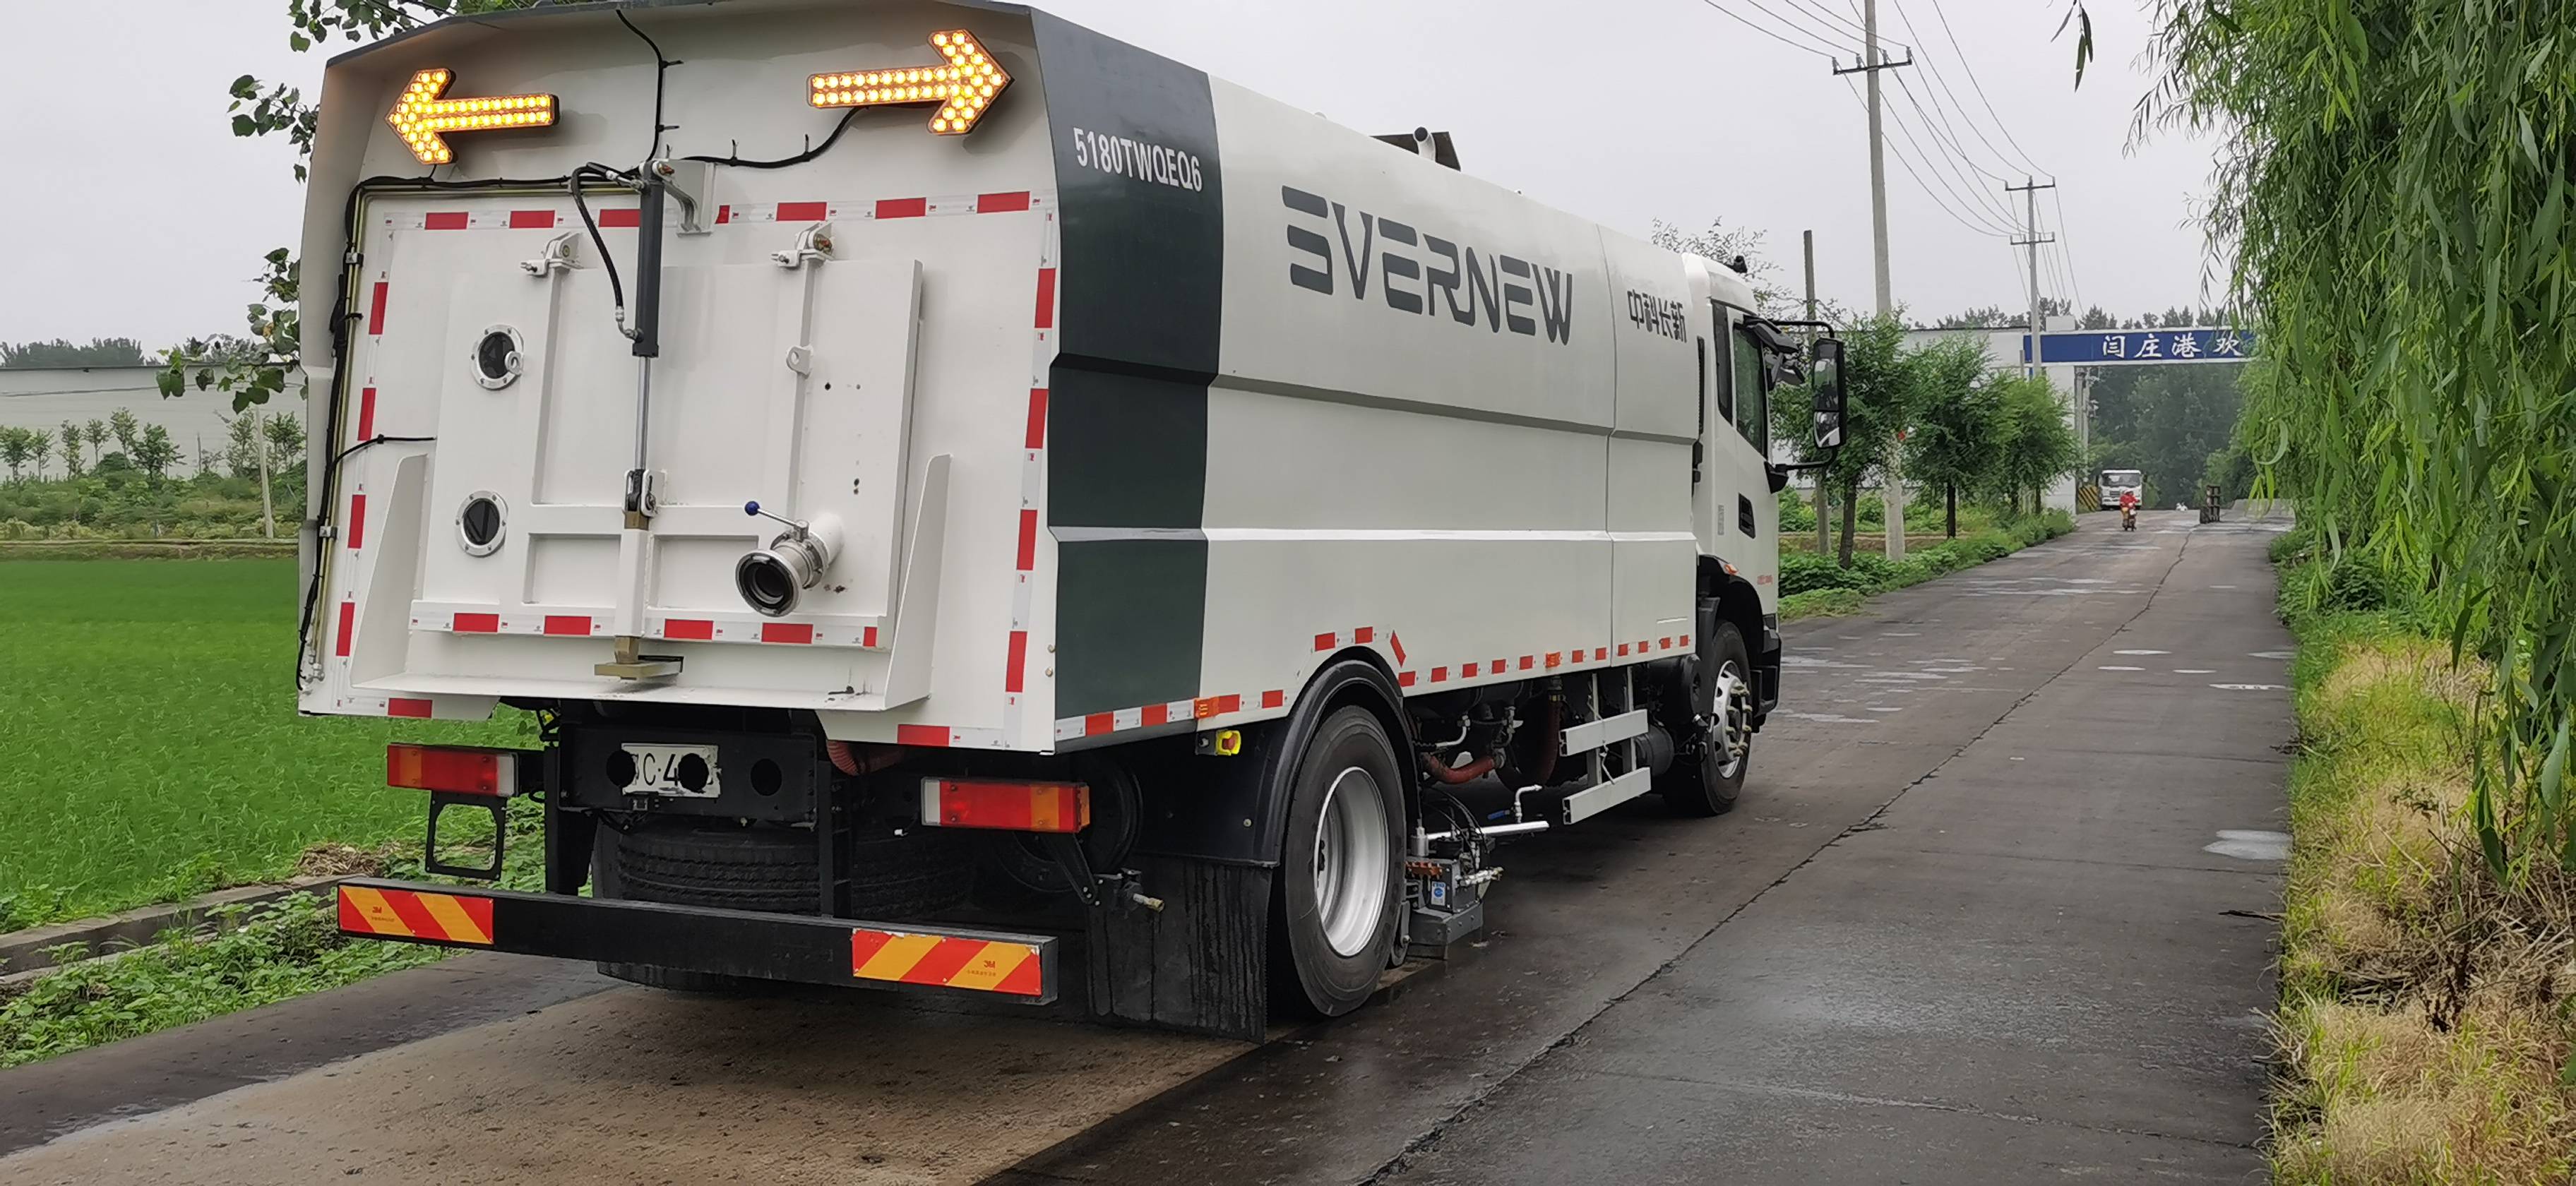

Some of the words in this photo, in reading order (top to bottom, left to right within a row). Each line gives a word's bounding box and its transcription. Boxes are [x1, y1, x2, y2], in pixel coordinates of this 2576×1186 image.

[1073, 127, 1203, 193] 5180TWQEQ6
[1627, 289, 1687, 343] 中科长新
